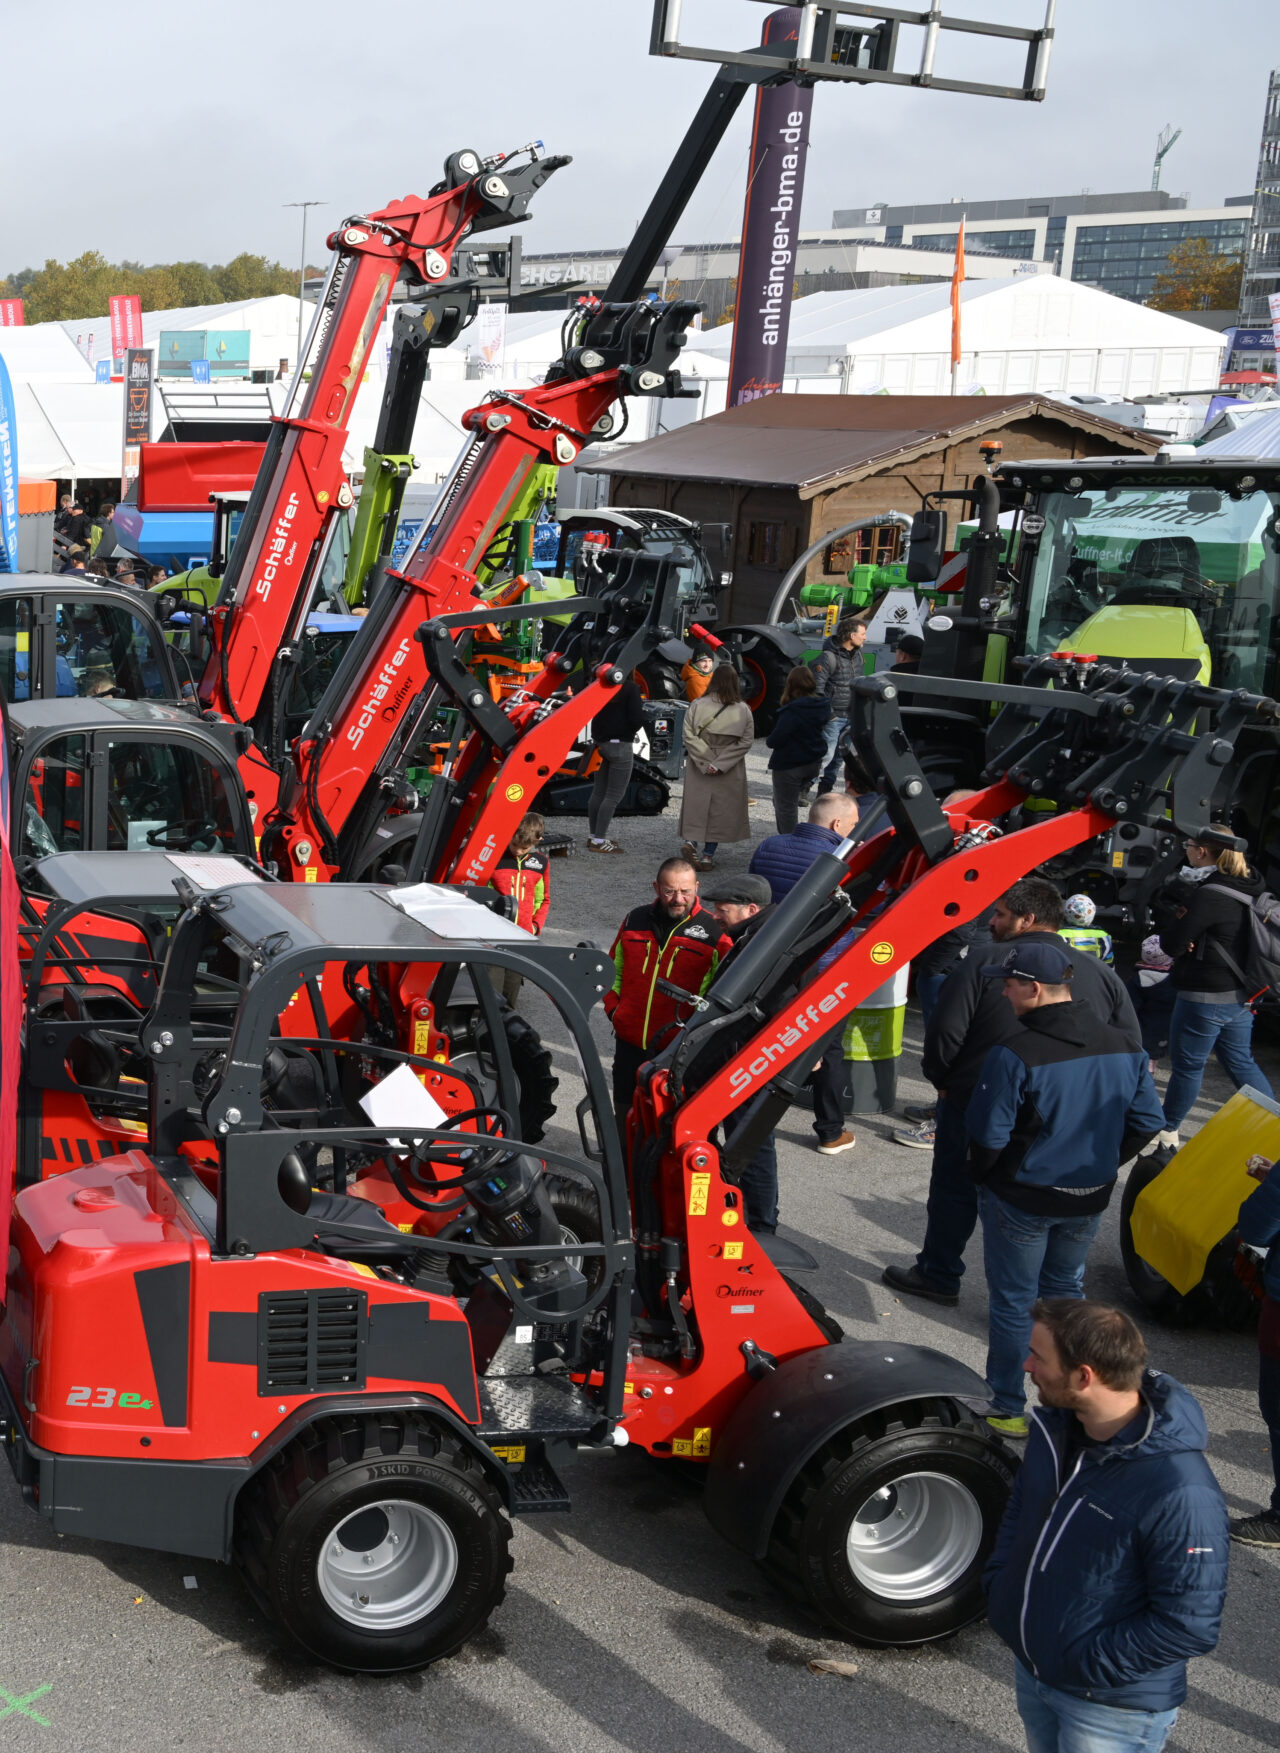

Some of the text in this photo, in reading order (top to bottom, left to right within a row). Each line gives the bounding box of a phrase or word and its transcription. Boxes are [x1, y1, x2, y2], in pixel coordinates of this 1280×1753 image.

[761, 110, 803, 346] anhänger-bma.de
[1115, 475, 1209, 484] AXION
[256, 492, 300, 603] Schäffer
[347, 638, 411, 751] Schäffer
[729, 981, 849, 1099] Schäffer
[716, 1284, 765, 1299] Duffner
[65, 1386, 141, 1409] 23e
[380, 1464, 410, 1476] SKID
